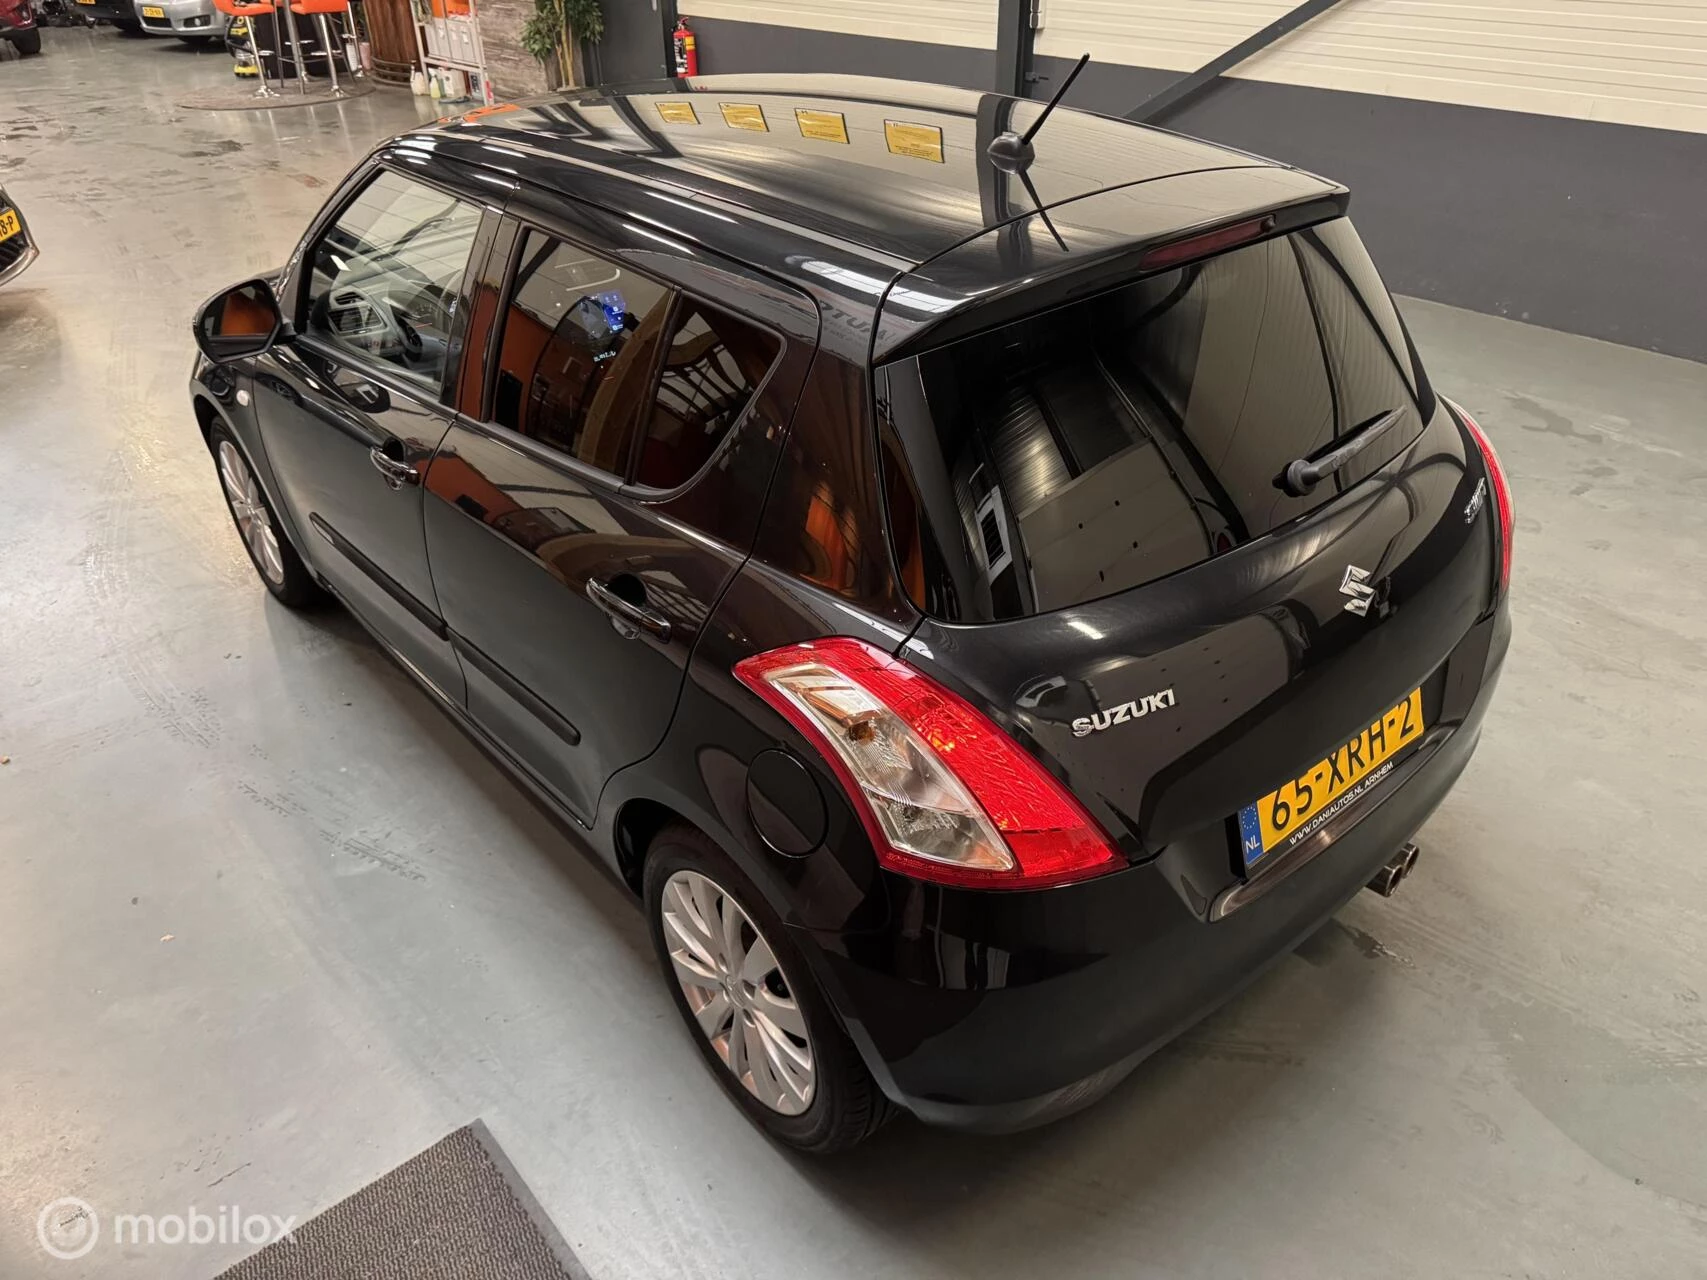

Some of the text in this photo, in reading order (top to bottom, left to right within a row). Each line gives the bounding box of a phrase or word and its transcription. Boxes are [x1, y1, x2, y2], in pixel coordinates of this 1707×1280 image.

[0, 215, 14, 238] 8-P
[1072, 688, 1175, 738] SUZUKI
[1272, 696, 1414, 831] 65-XRH-2
[1289, 761, 1394, 845] WWW.DANIAUTOS.NL ARNHEM
[1245, 834, 1261, 854] NL
